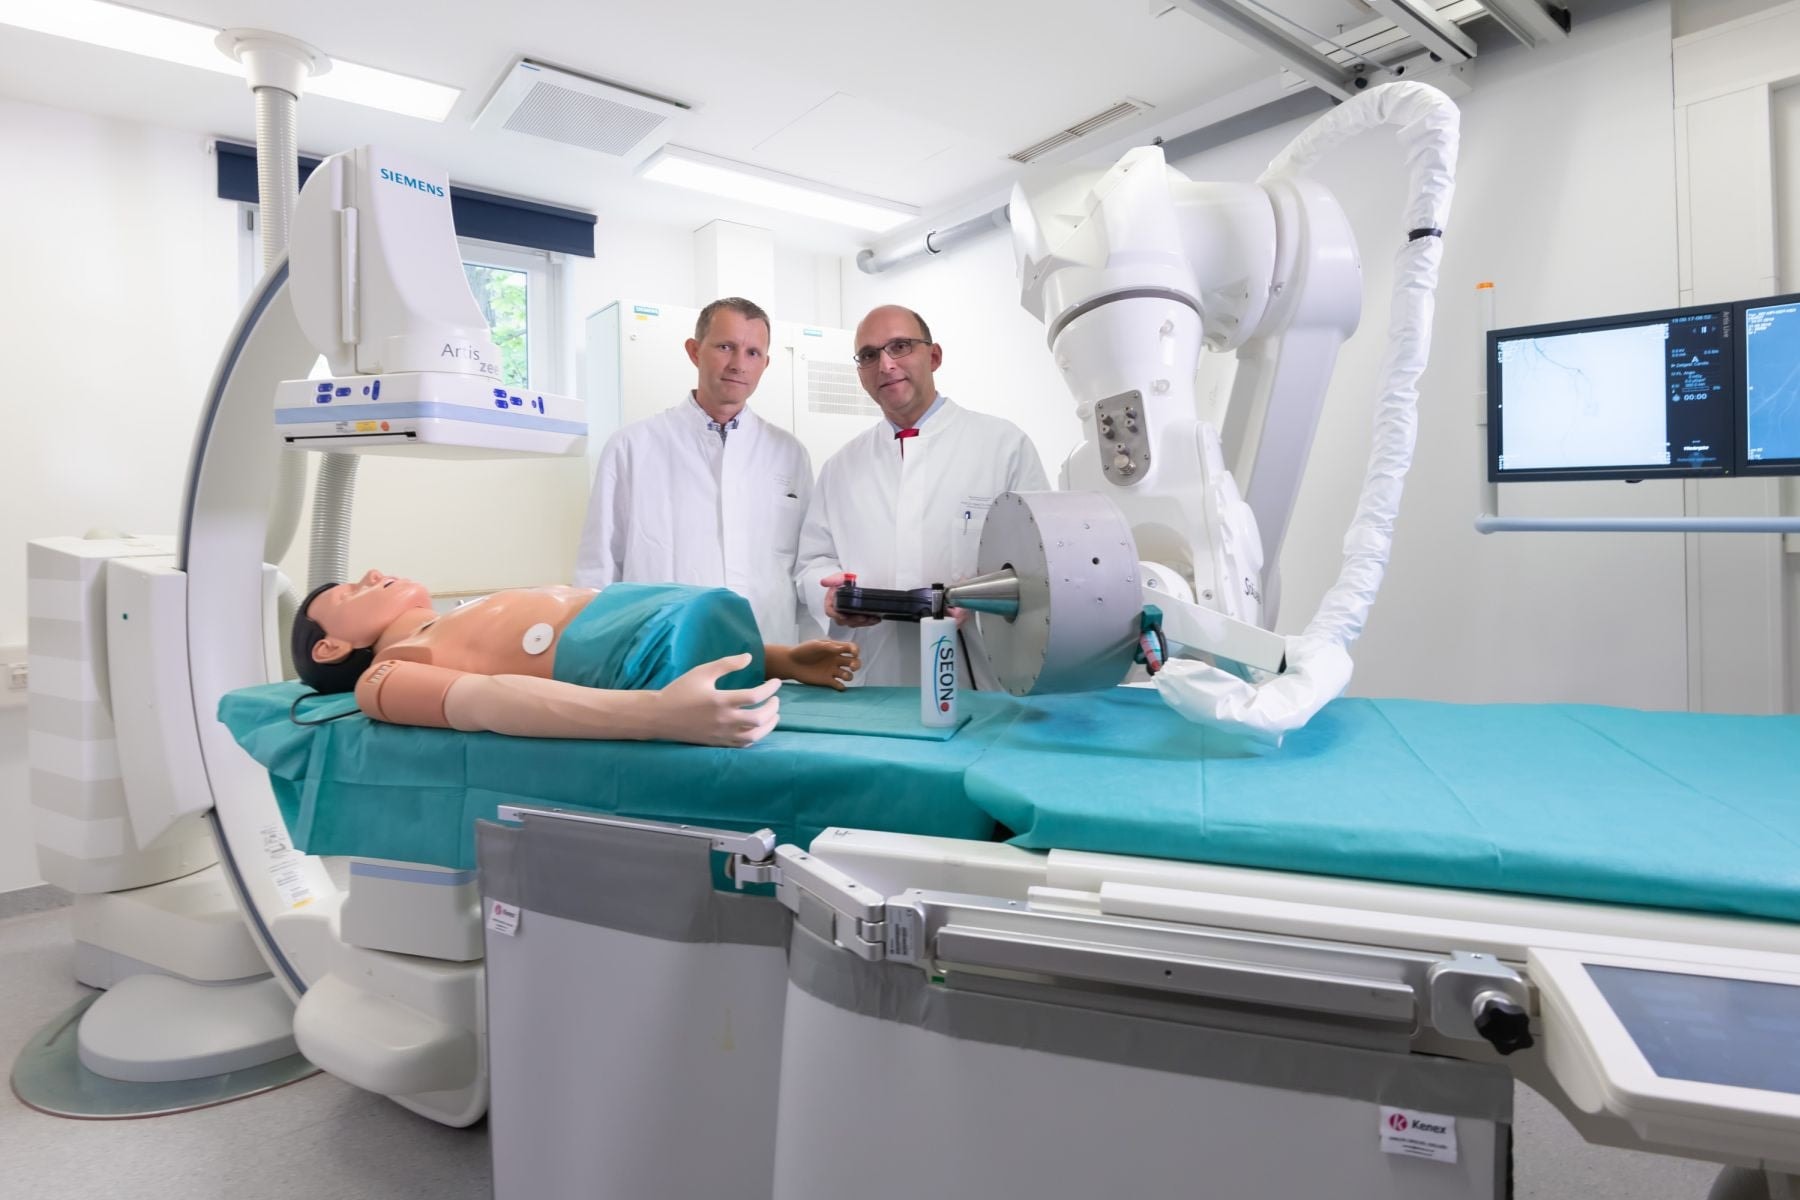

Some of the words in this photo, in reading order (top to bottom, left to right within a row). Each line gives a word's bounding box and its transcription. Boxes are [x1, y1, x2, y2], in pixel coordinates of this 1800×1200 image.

[380, 168, 445, 197] SIEMENS
[441, 343, 480, 361] Aris
[939, 647, 954, 701] SEON
[1411, 1119, 1447, 1135] Kenex
